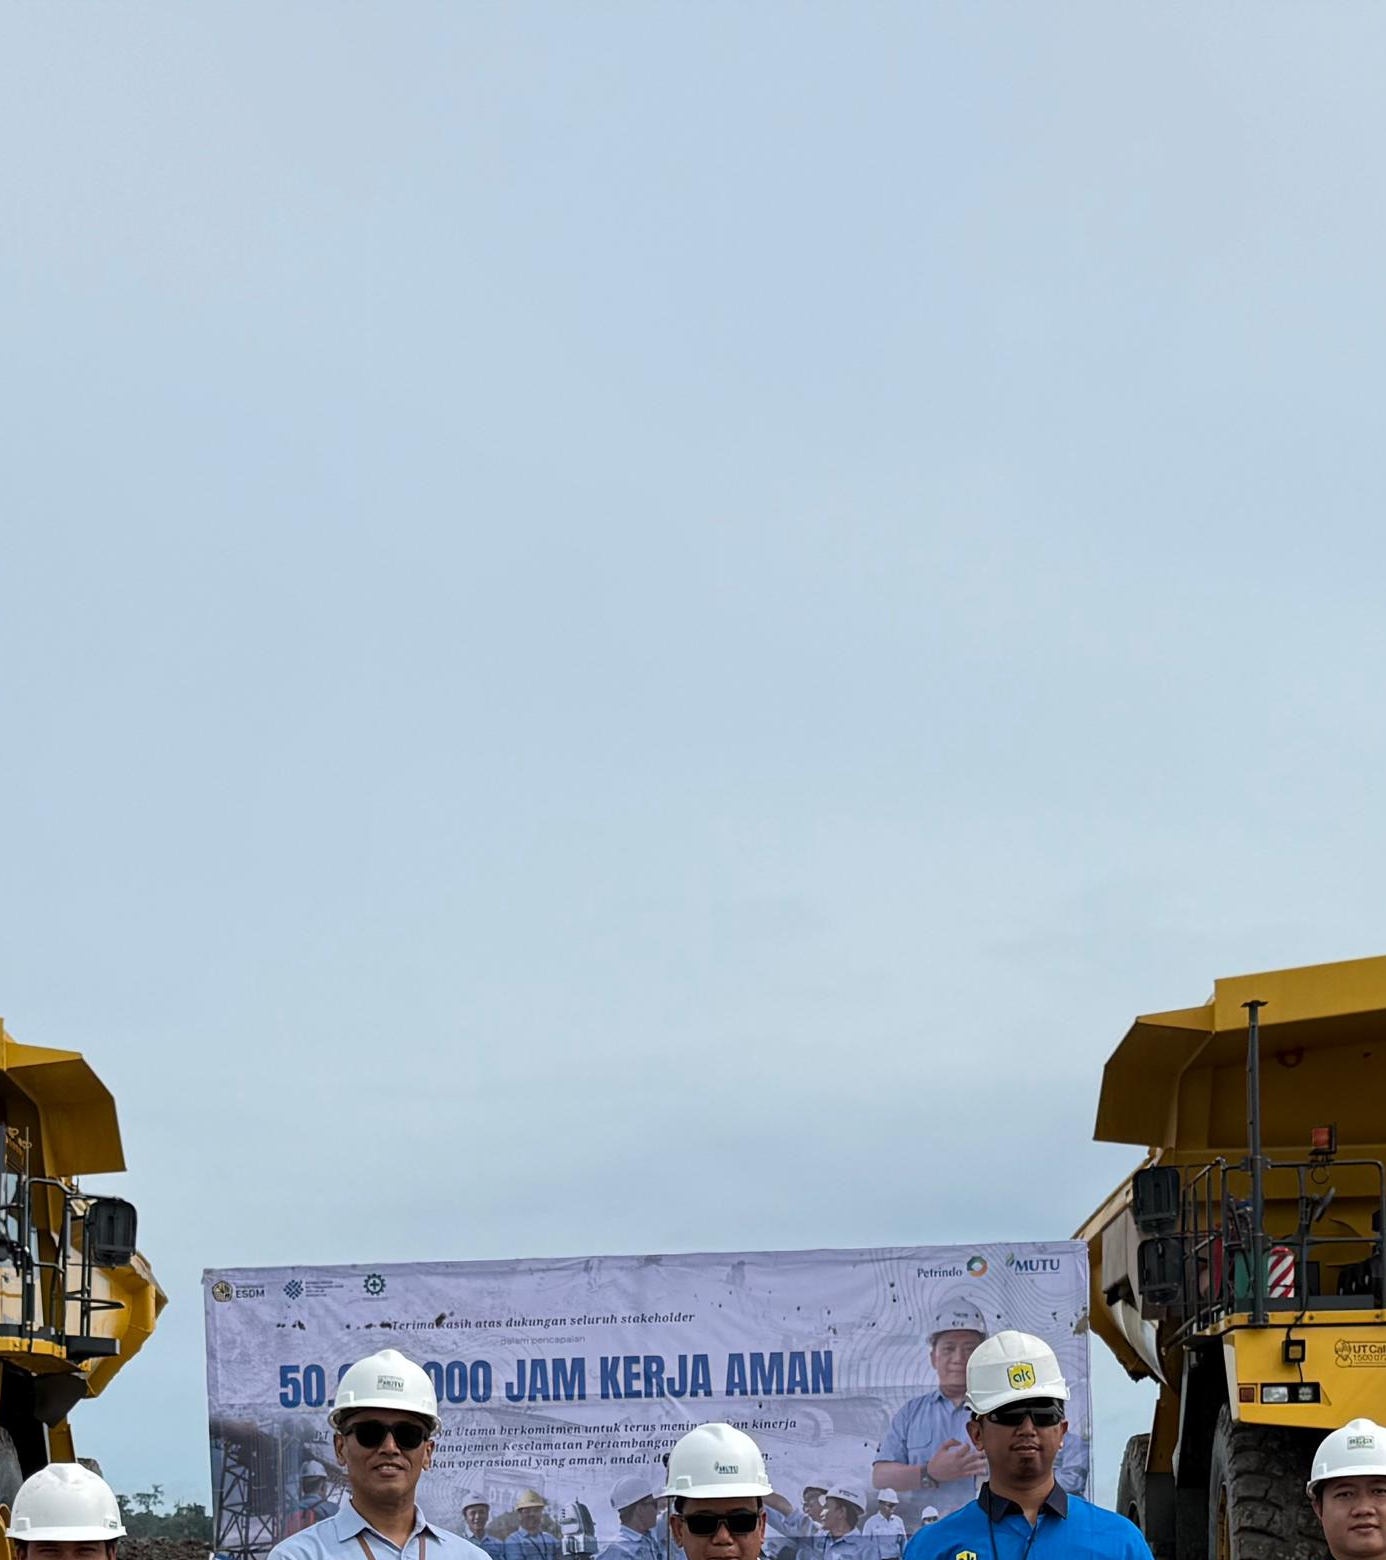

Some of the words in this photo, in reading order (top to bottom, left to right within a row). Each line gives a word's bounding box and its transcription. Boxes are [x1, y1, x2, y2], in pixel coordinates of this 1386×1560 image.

[917, 1266, 963, 1278] Petrindo
[1015, 1258, 1061, 1272] MUTU
[235, 1289, 265, 1299] ESDM
[393, 1320, 435, 1331] Terima
[475, 1317, 502, 1329] atas
[506, 1314, 568, 1331] dukungan
[570, 1314, 618, 1326] seluruh
[620, 1311, 696, 1325] stakeholder
[505, 1356, 586, 1403] JAM
[599, 1353, 713, 1400] KERJA
[725, 1349, 834, 1397] AMAN
[456, 1426, 496, 1437] Utama
[500, 1423, 582, 1436] berkomitmen
[584, 1422, 621, 1433] untuk
[624, 1422, 657, 1433] terus
[751, 1418, 797, 1431] kinerja
[503, 1439, 583, 1451] Keselamatan
[458, 1457, 532, 1470] operasional
[535, 1456, 565, 1469] yang
[569, 1455, 607, 1466] aman,
[610, 1453, 650, 1465] andal,
